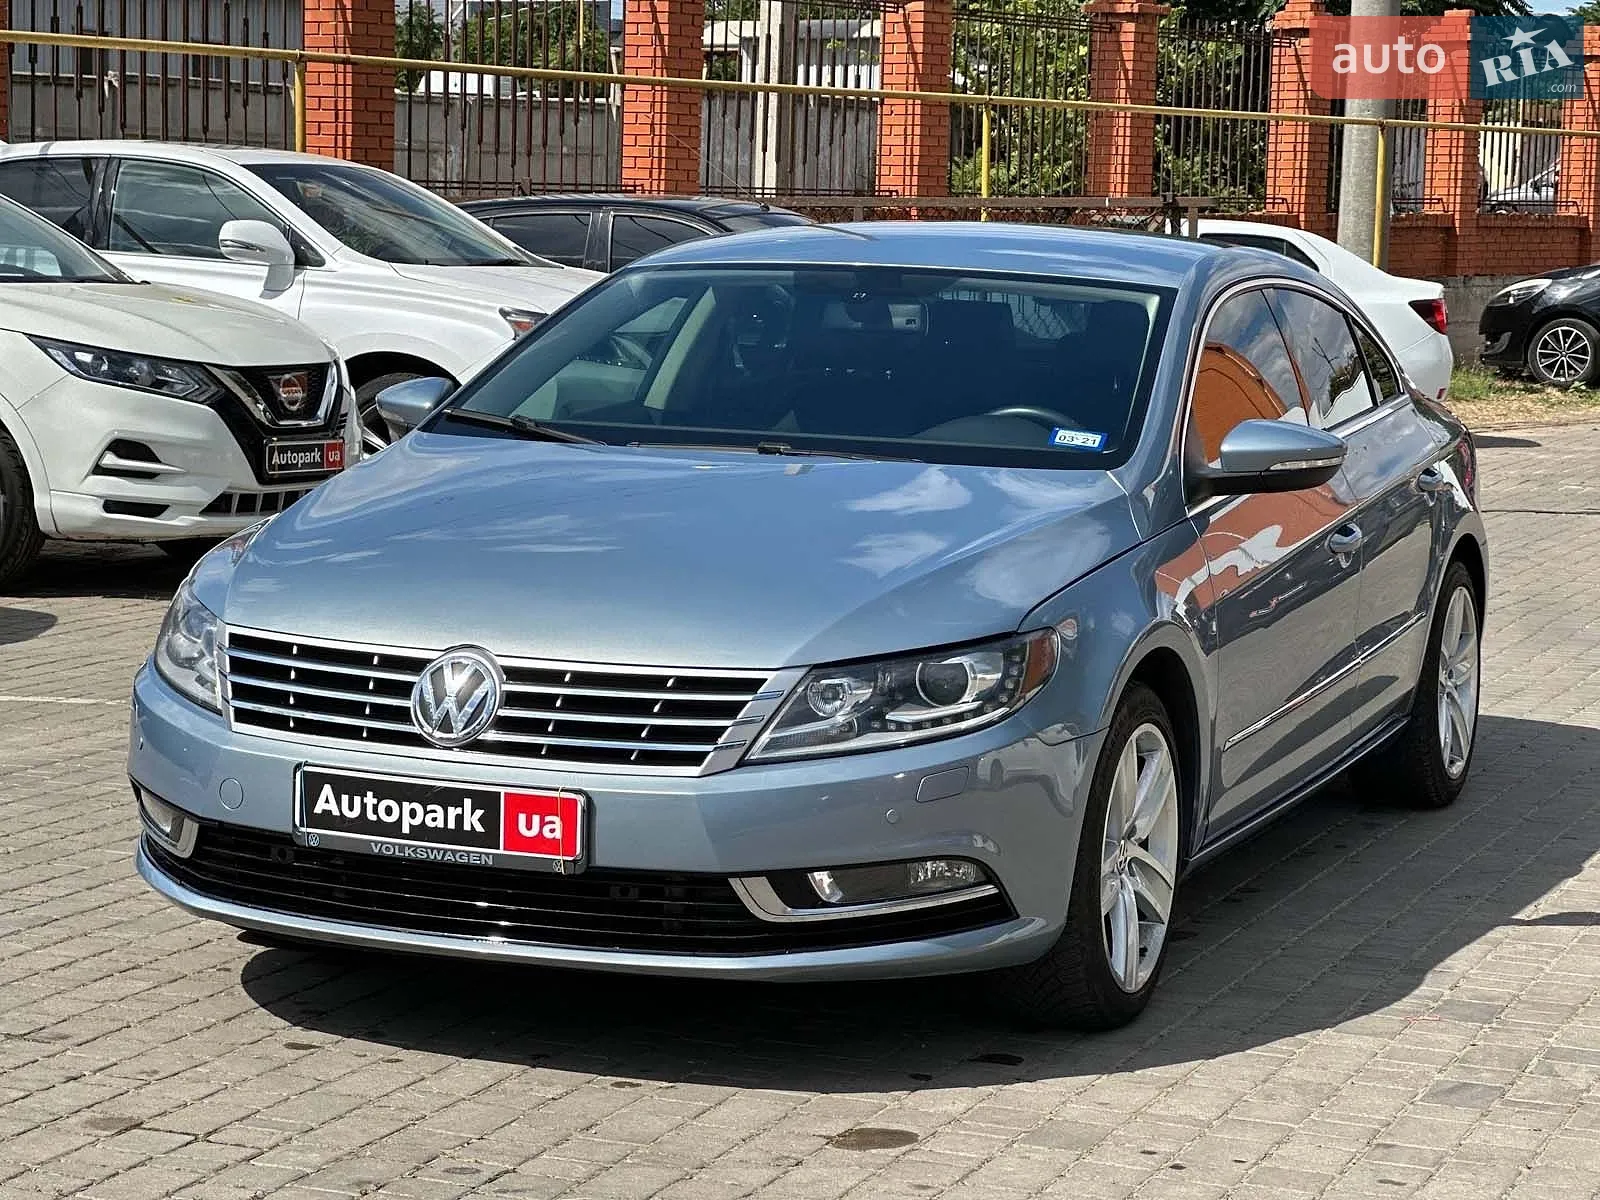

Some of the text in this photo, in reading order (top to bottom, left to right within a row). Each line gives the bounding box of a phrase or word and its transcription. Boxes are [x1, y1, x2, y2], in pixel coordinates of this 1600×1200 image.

[271, 447, 341, 468] Autopark ua
[313, 783, 562, 840] Autopark ua
[370, 842, 494, 865] VOLKSWAGEN
